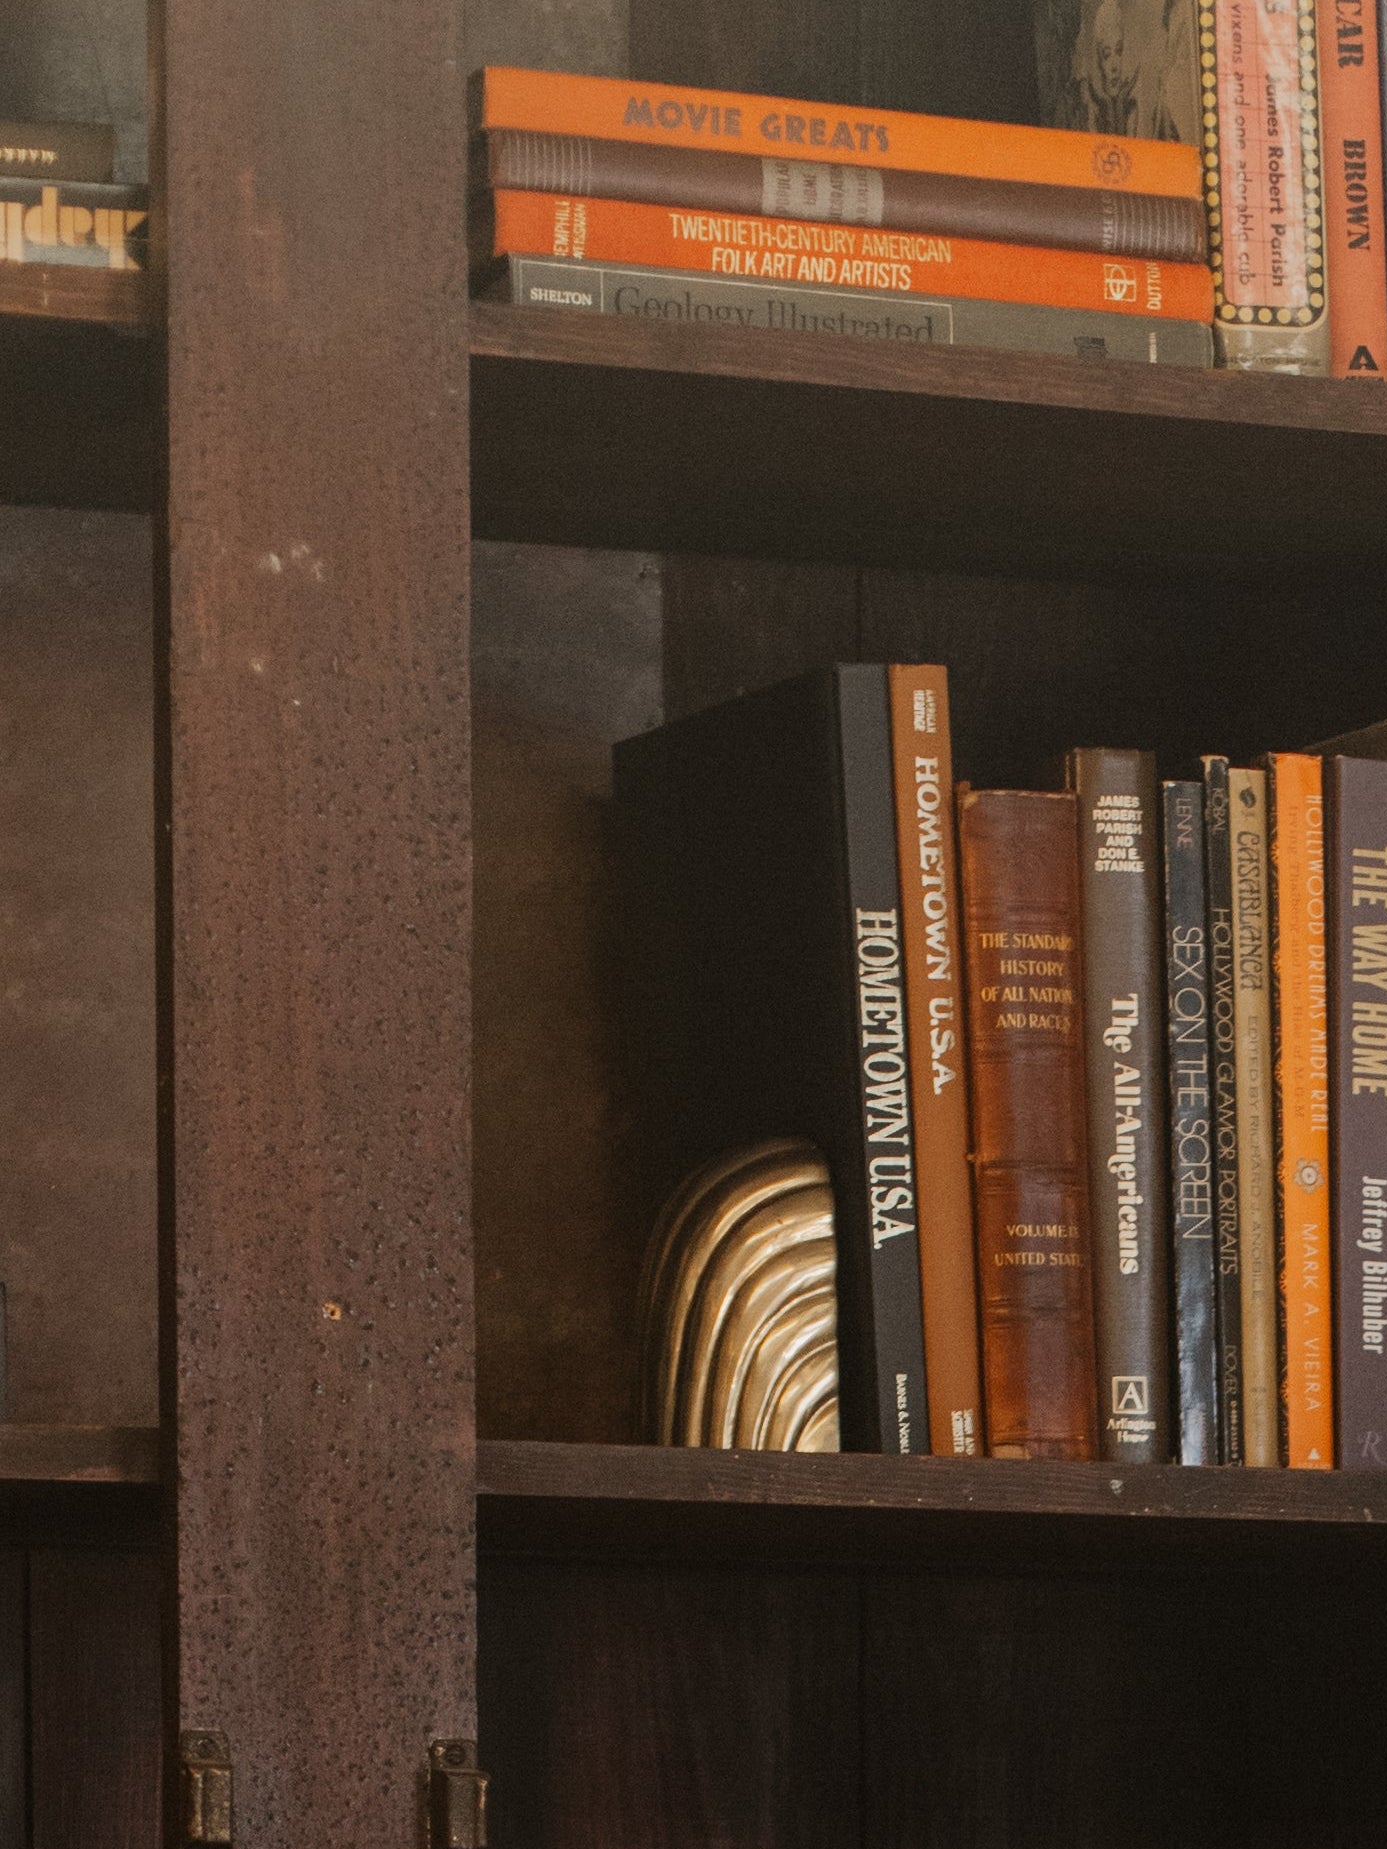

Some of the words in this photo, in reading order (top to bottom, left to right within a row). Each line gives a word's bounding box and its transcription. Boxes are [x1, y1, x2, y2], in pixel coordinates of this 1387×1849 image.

[1231, 4, 1243, 63] vixens
[1234, 71, 1251, 105] and
[1265, 74, 1279, 137] James
[623, 95, 742, 138] MOVIE
[759, 112, 890, 152] GREATS
[1235, 115, 1246, 150] one
[1236, 160, 1254, 242] adorable
[1268, 146, 1285, 214] Robert
[1343, 139, 1371, 252] BROWN
[668, 212, 856, 255] TWENTIETH-CENTURY
[861, 232, 951, 264] AMERICAN
[1270, 224, 1287, 287] Parish
[529, 287, 593, 306] SHELTON
[711, 246, 757, 276] FOLK
[760, 251, 796, 279] ART
[797, 255, 836, 284] AND
[838, 258, 912, 291] ARTISTS
[1239, 252, 1256, 286] cub
[767, 299, 934, 344] Illustrated
[1092, 809, 1143, 822] ROBERT
[1095, 822, 1143, 835] PARISH
[1096, 795, 1141, 808] JAMES
[915, 756, 952, 982] HOMETOWN
[1094, 860, 1146, 873] STANKE
[1098, 848, 1127, 860] DON
[1105, 835, 1135, 848] AND
[1304, 795, 1325, 935] HOLLYWOOD
[1238, 830, 1266, 992] CASABLANCA
[979, 932, 1010, 950] THE
[999, 959, 1064, 977] HISTORY
[1172, 925, 1206, 981] SEX
[979, 985, 1000, 1003] OF
[1002, 986, 1026, 1004] ALL
[1213, 907, 1234, 1053] HOLLYWOOD
[1307, 945, 1328, 1020] DREAMS
[856, 907, 911, 1146] HOMETOWN
[995, 1012, 1027, 1030] AND
[1103, 992, 1140, 1054] The
[1174, 986, 1207, 1044] ON
[929, 996, 956, 1095] U.S.A.
[1309, 1029, 1329, 1081] MADE
[1177, 1053, 1209, 1107] THE
[1216, 1062, 1238, 1158] GLAMOR
[1309, 1089, 1330, 1132] REAL
[1106, 1060, 1145, 1276] All-Americans
[1178, 1117, 1213, 1240] SCREEN
[868, 1155, 915, 1250] U.S.A.
[1220, 1169, 1240, 1275] PORTRAITS
[1005, 1223, 1068, 1239] VOLUME
[1301, 1222, 1320, 1289] MARK
[993, 1251, 1046, 1268] UNITED
[1303, 1337, 1321, 1412] VIEIRA
